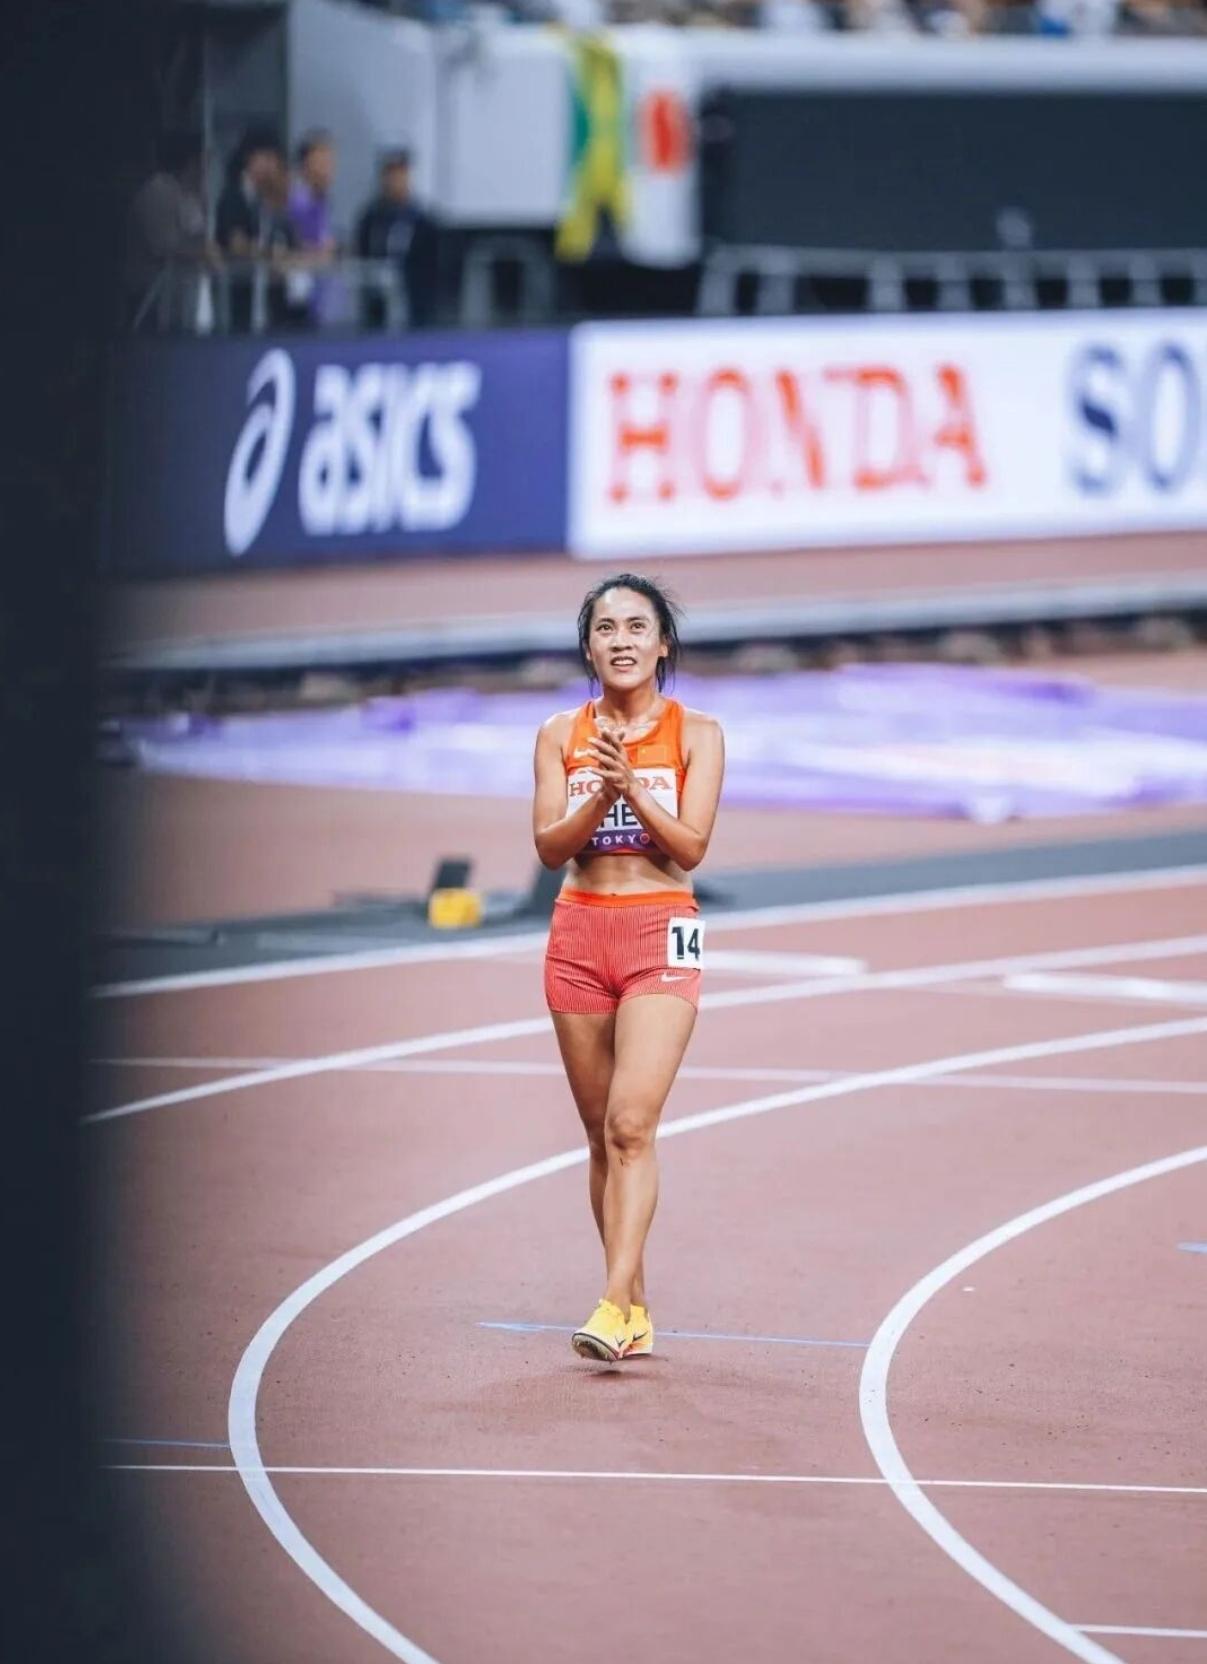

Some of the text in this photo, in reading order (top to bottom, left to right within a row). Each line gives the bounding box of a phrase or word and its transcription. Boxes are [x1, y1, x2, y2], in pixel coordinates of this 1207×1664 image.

[299, 361, 481, 536] asics
[607, 364, 988, 503] HONDA
[569, 775, 672, 797] HODA
[591, 832, 650, 846] TOKYO
[672, 926, 701, 961] 14
